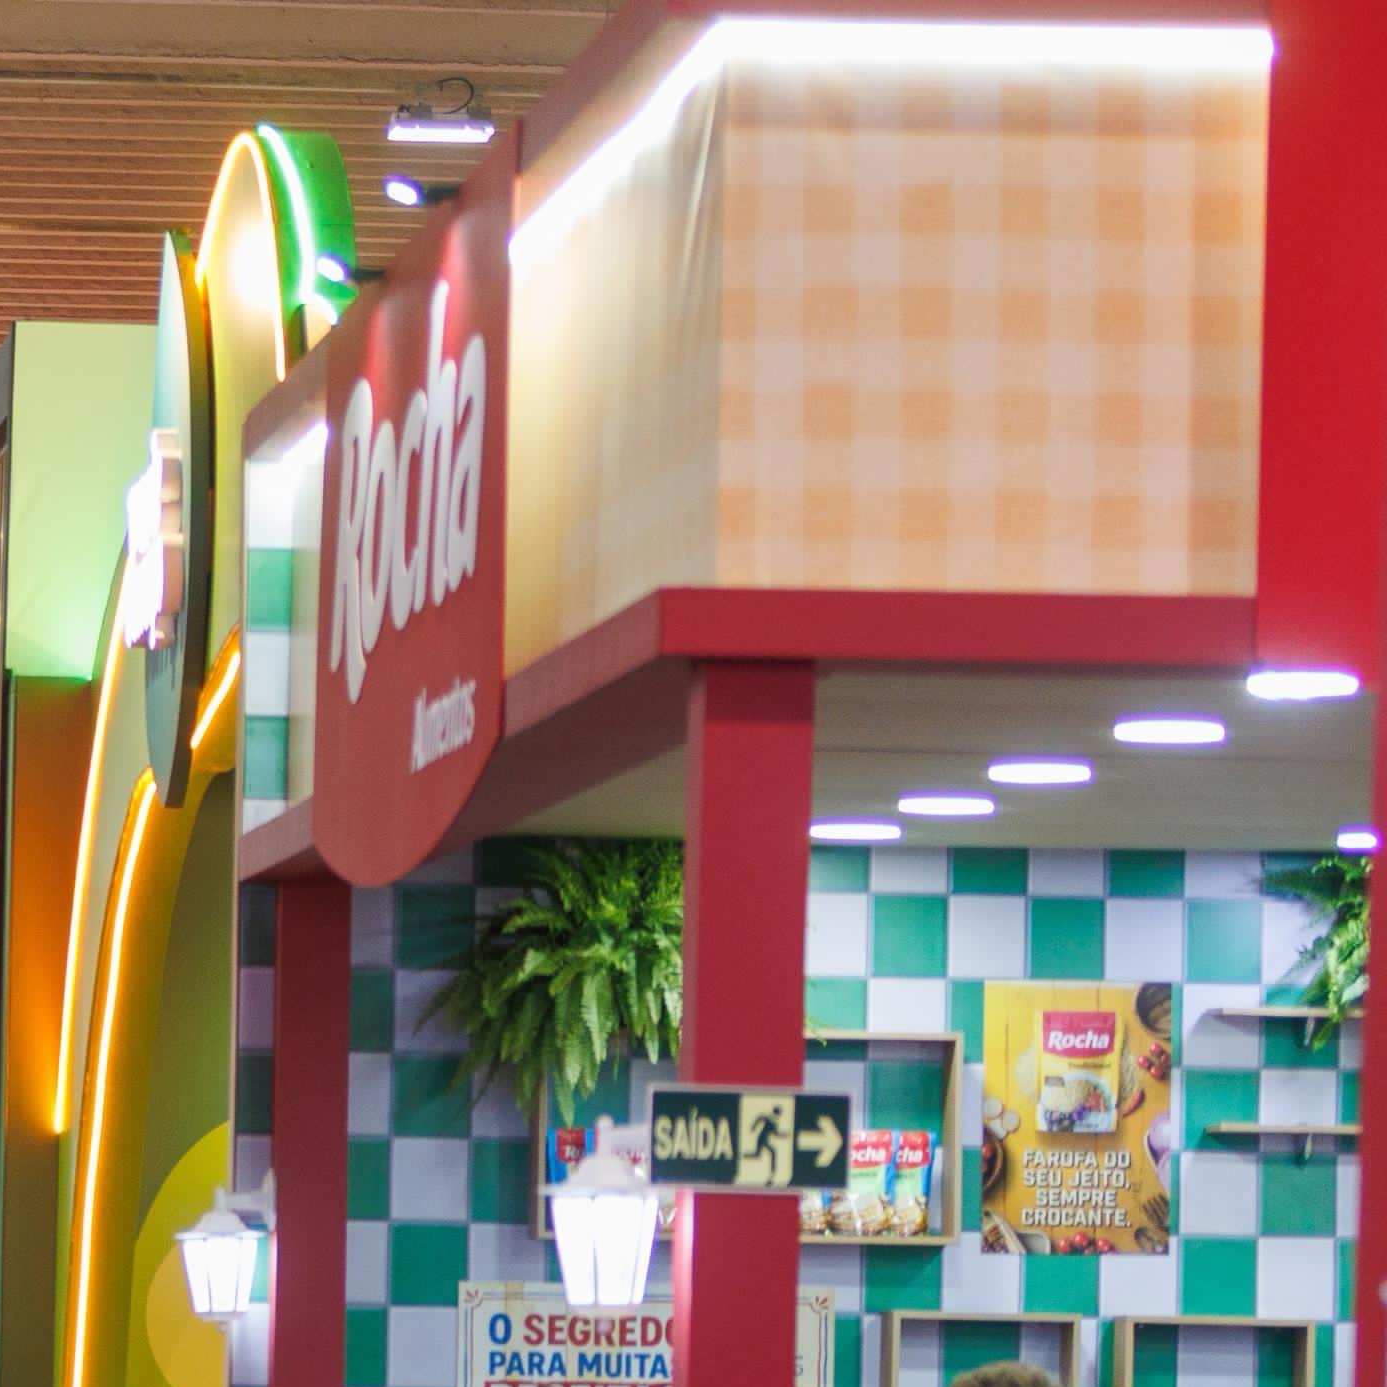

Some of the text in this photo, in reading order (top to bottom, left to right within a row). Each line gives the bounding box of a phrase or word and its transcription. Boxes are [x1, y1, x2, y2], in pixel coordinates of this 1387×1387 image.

[331, 279, 487, 705] Rocha
[1047, 1030, 1110, 1051] Rocha
[653, 1105, 734, 1160] SAÍDA
[850, 1146, 886, 1163] ocha
[1023, 1149, 1131, 1168] FAROFA DO
[1023, 1169, 1131, 1188] SEU JEITO,
[1036, 1189, 1116, 1207] SEMPRE
[1022, 1208, 1131, 1227] CROCANTE.
[489, 1313, 512, 1345] O
[489, 1351, 673, 1378] PARA MUITA
